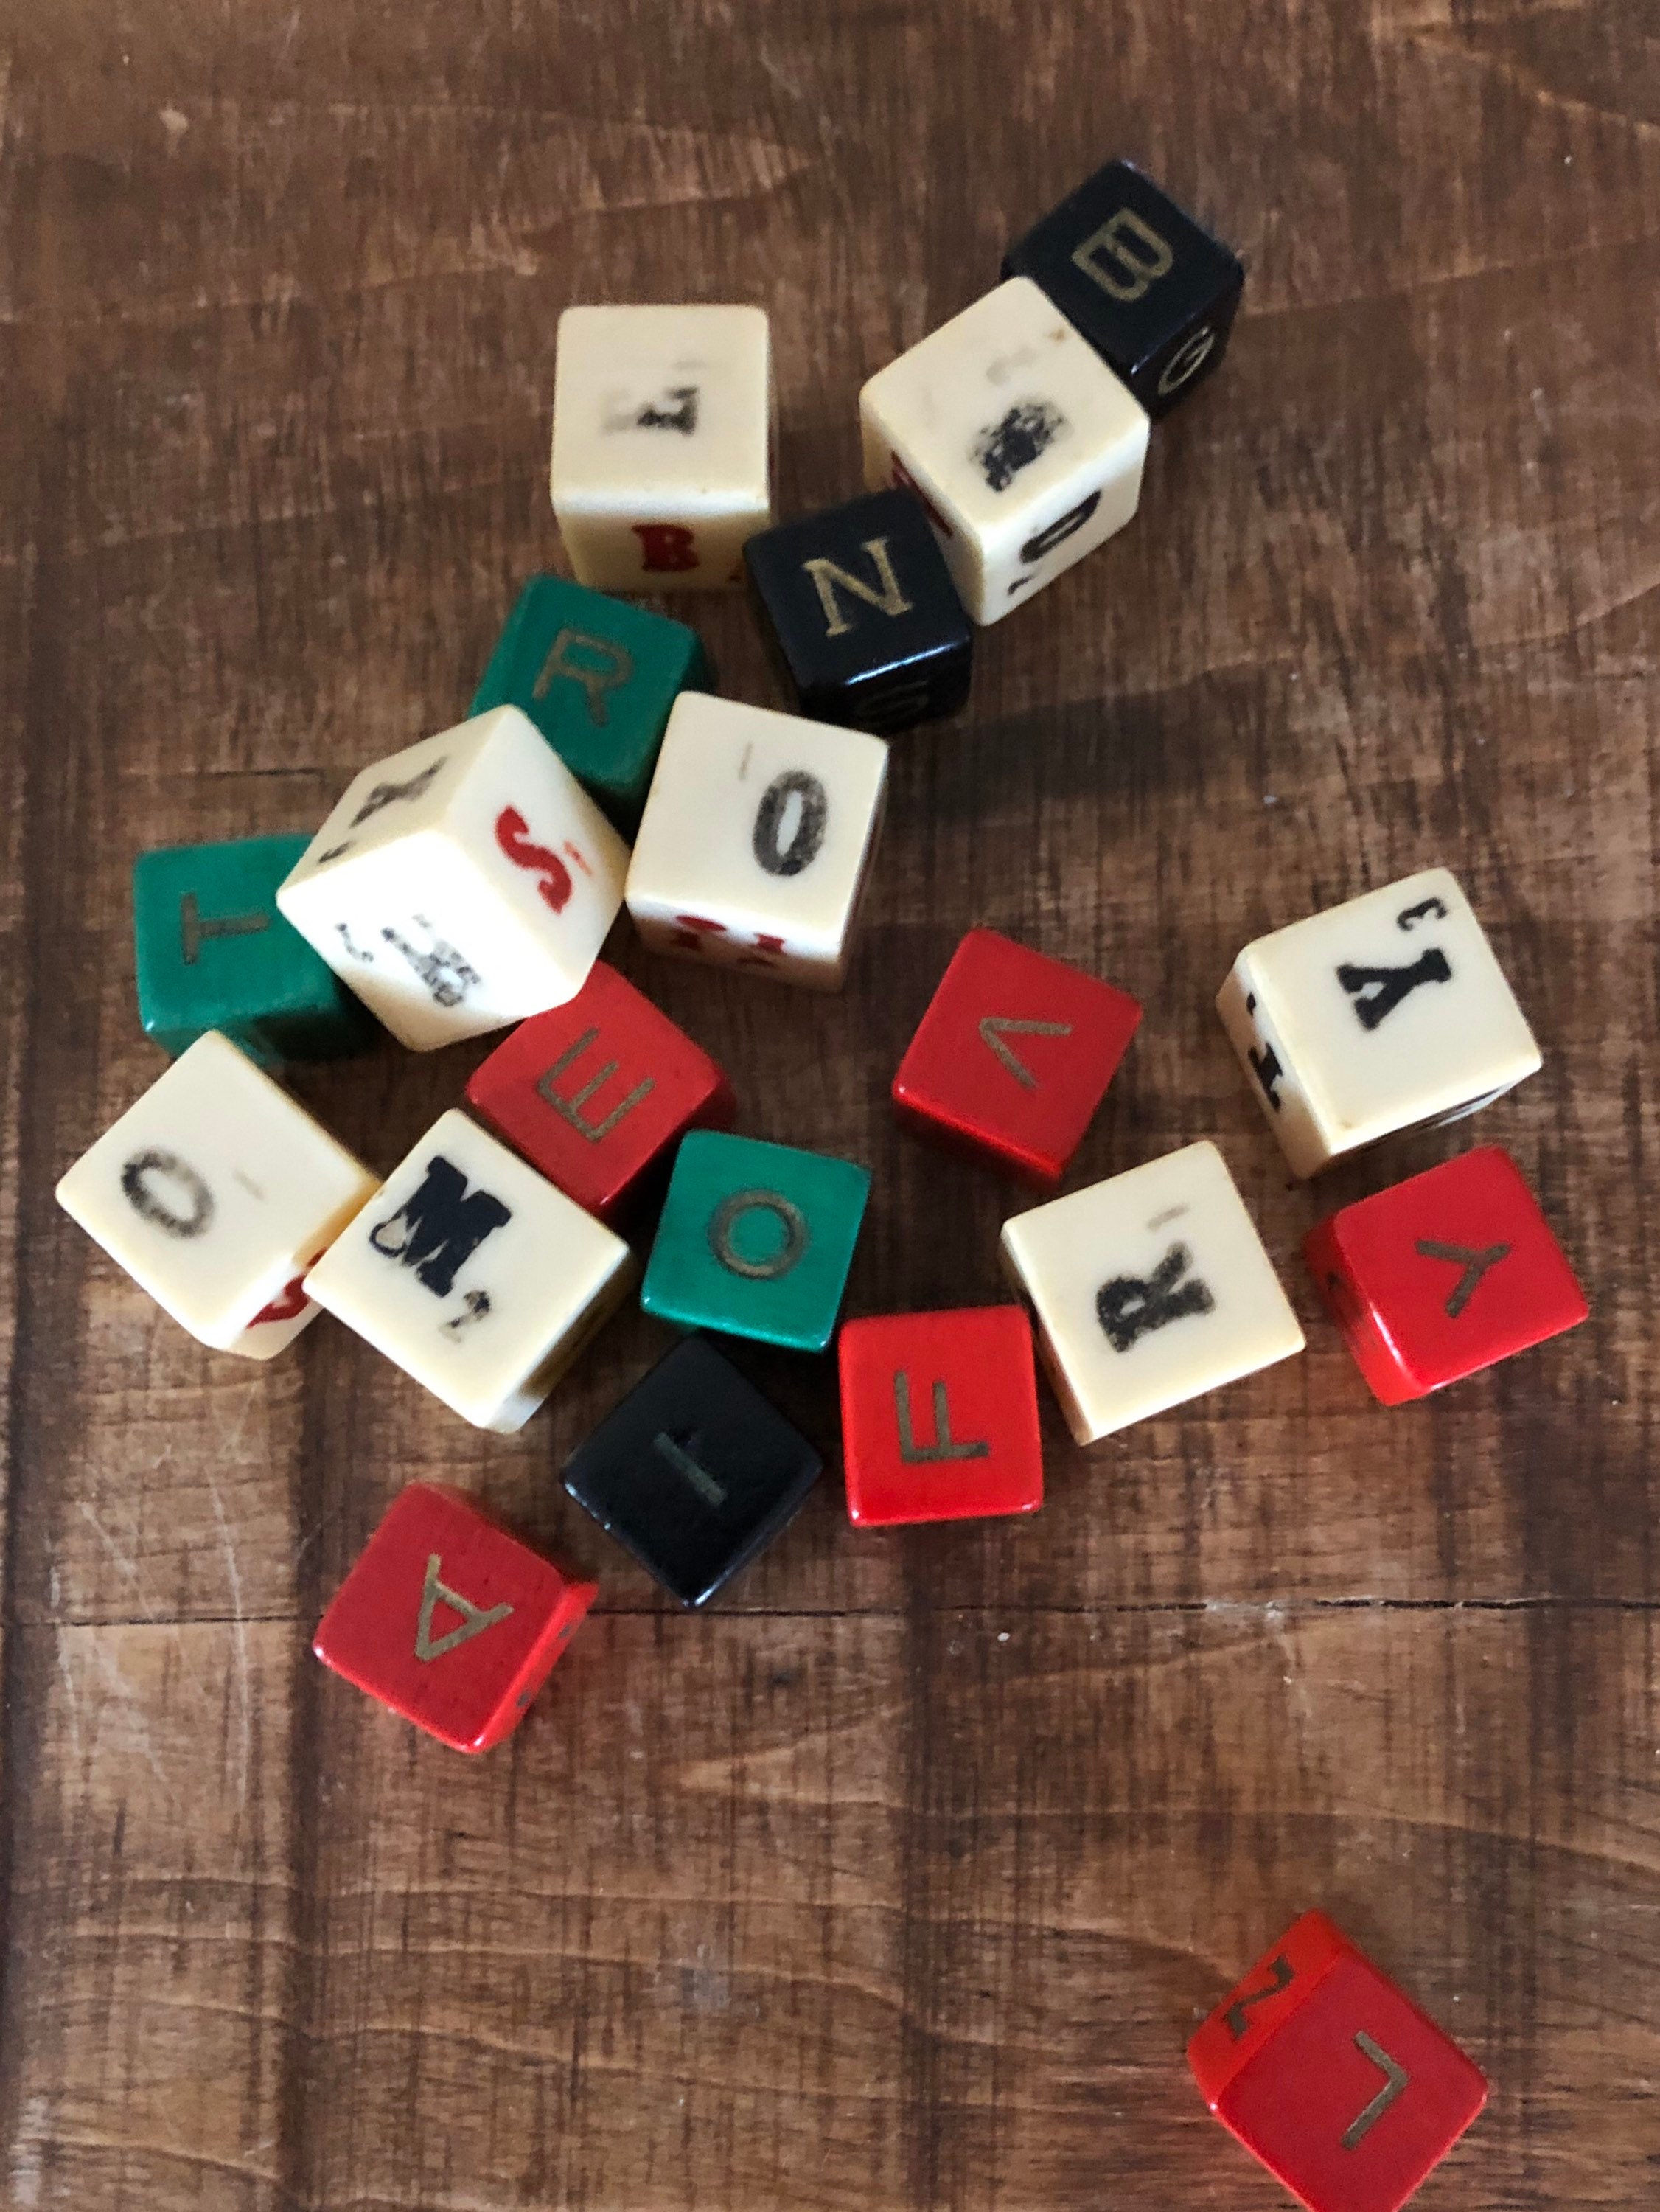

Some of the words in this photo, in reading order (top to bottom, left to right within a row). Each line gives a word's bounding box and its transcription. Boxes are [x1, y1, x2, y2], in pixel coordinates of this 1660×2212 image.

[1071, 207, 1174, 303] B
[1157, 324, 1216, 396] G
[801, 535, 913, 638] N
[531, 627, 635, 728] R
[494, 804, 573, 915] S
[180, 891, 271, 966] T
[1335, 946, 1452, 1031] Y
[536, 1027, 655, 1143] E
[978, 1016, 1073, 1091] V
[369, 1155, 512, 1299] M
[707, 1186, 809, 1281] O
[1095, 1240, 1216, 1353] R
[1414, 1239, 1512, 1319] Y
[893, 1369, 990, 1465] F
[414, 1552, 515, 1663] A
[1339, 2028, 1410, 2151] L
